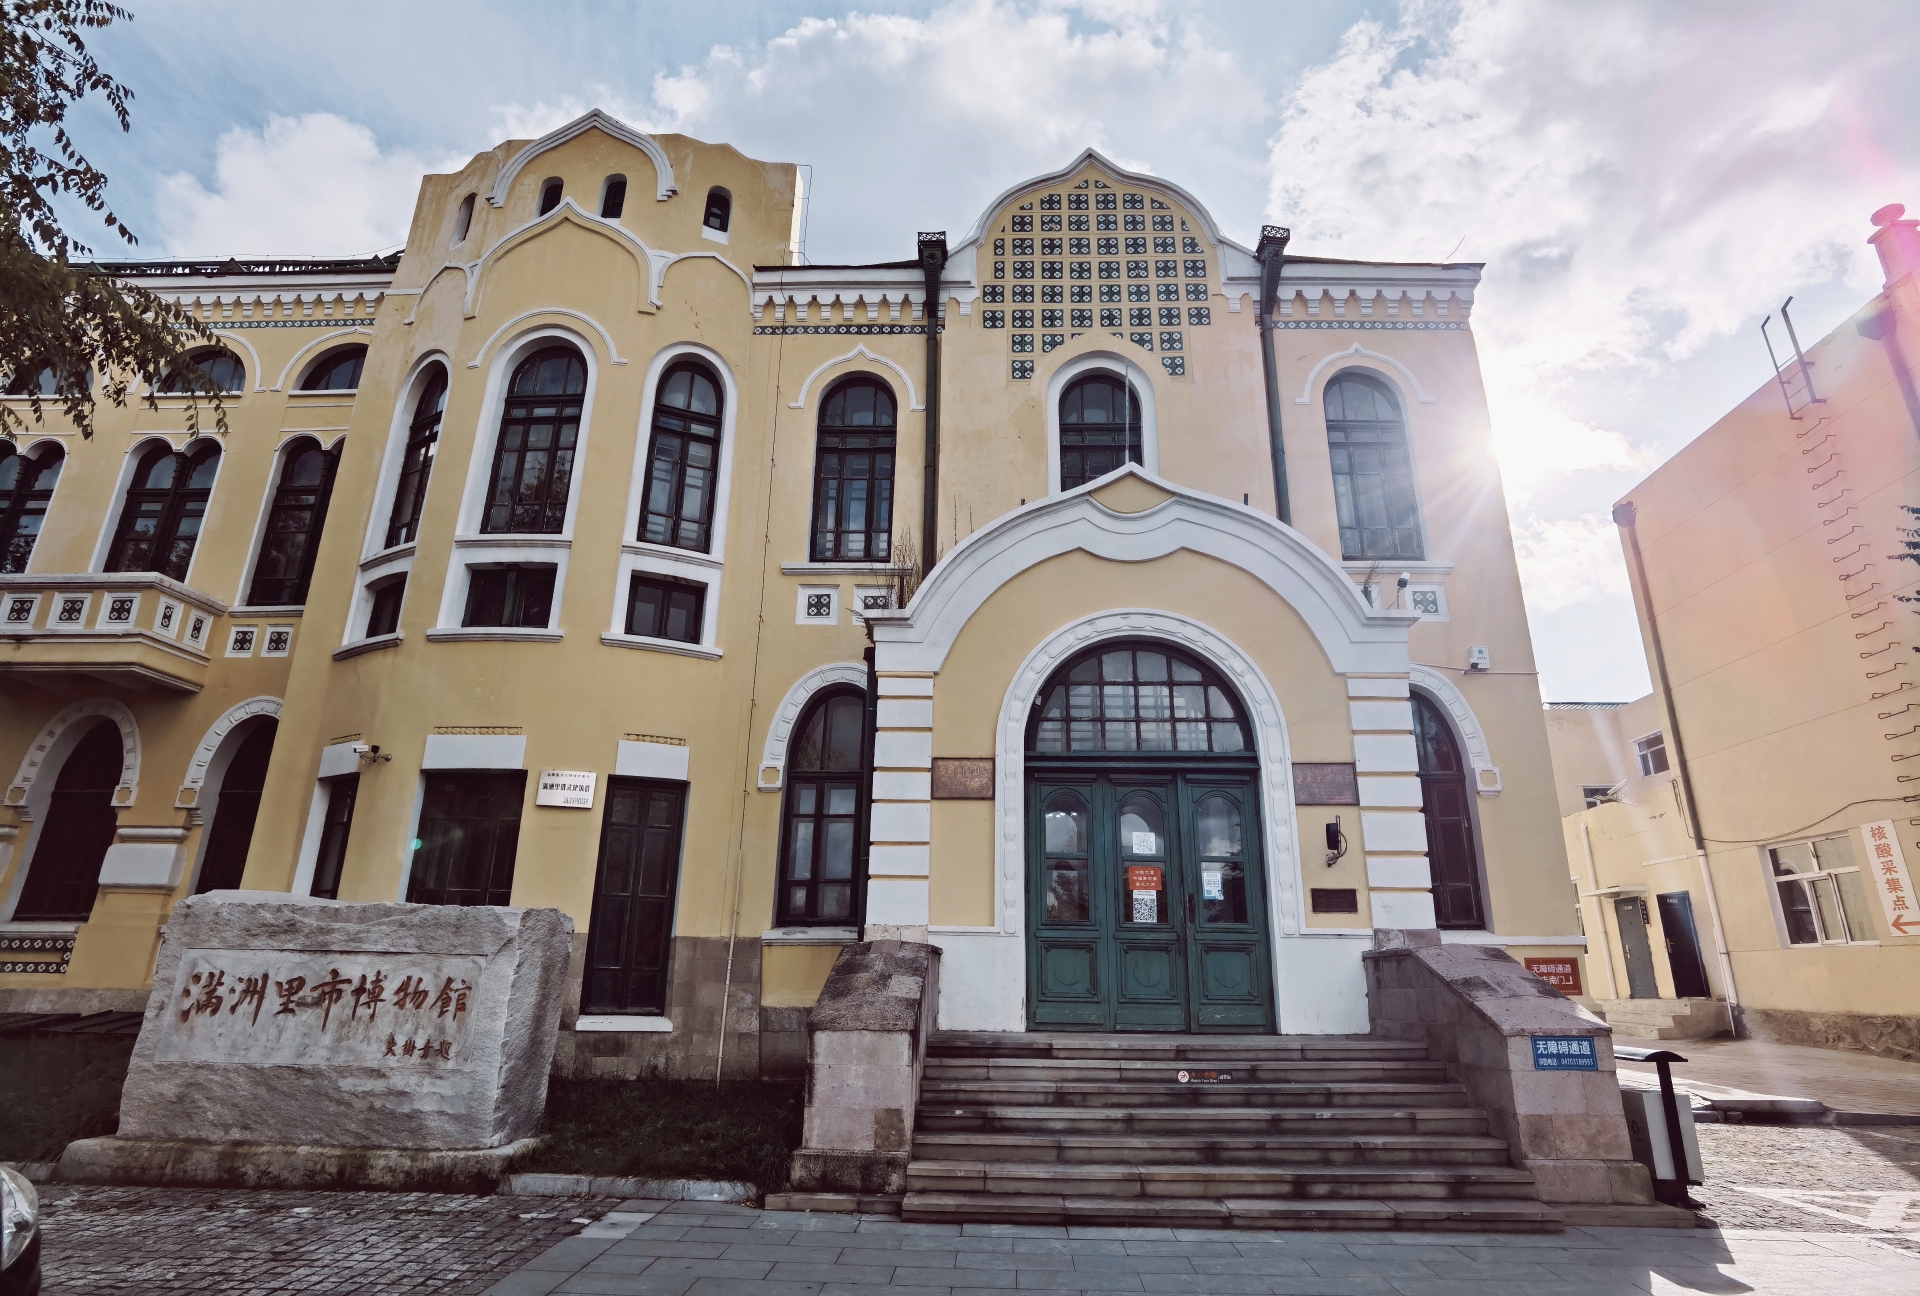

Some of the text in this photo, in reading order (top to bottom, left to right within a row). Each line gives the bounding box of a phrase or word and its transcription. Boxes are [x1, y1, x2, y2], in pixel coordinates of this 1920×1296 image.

[1869, 825, 1910, 911] 核酸采集点
[1531, 964, 1572, 974] 无障碍通道
[1536, 1040, 1592, 1055] 无障碍通道
